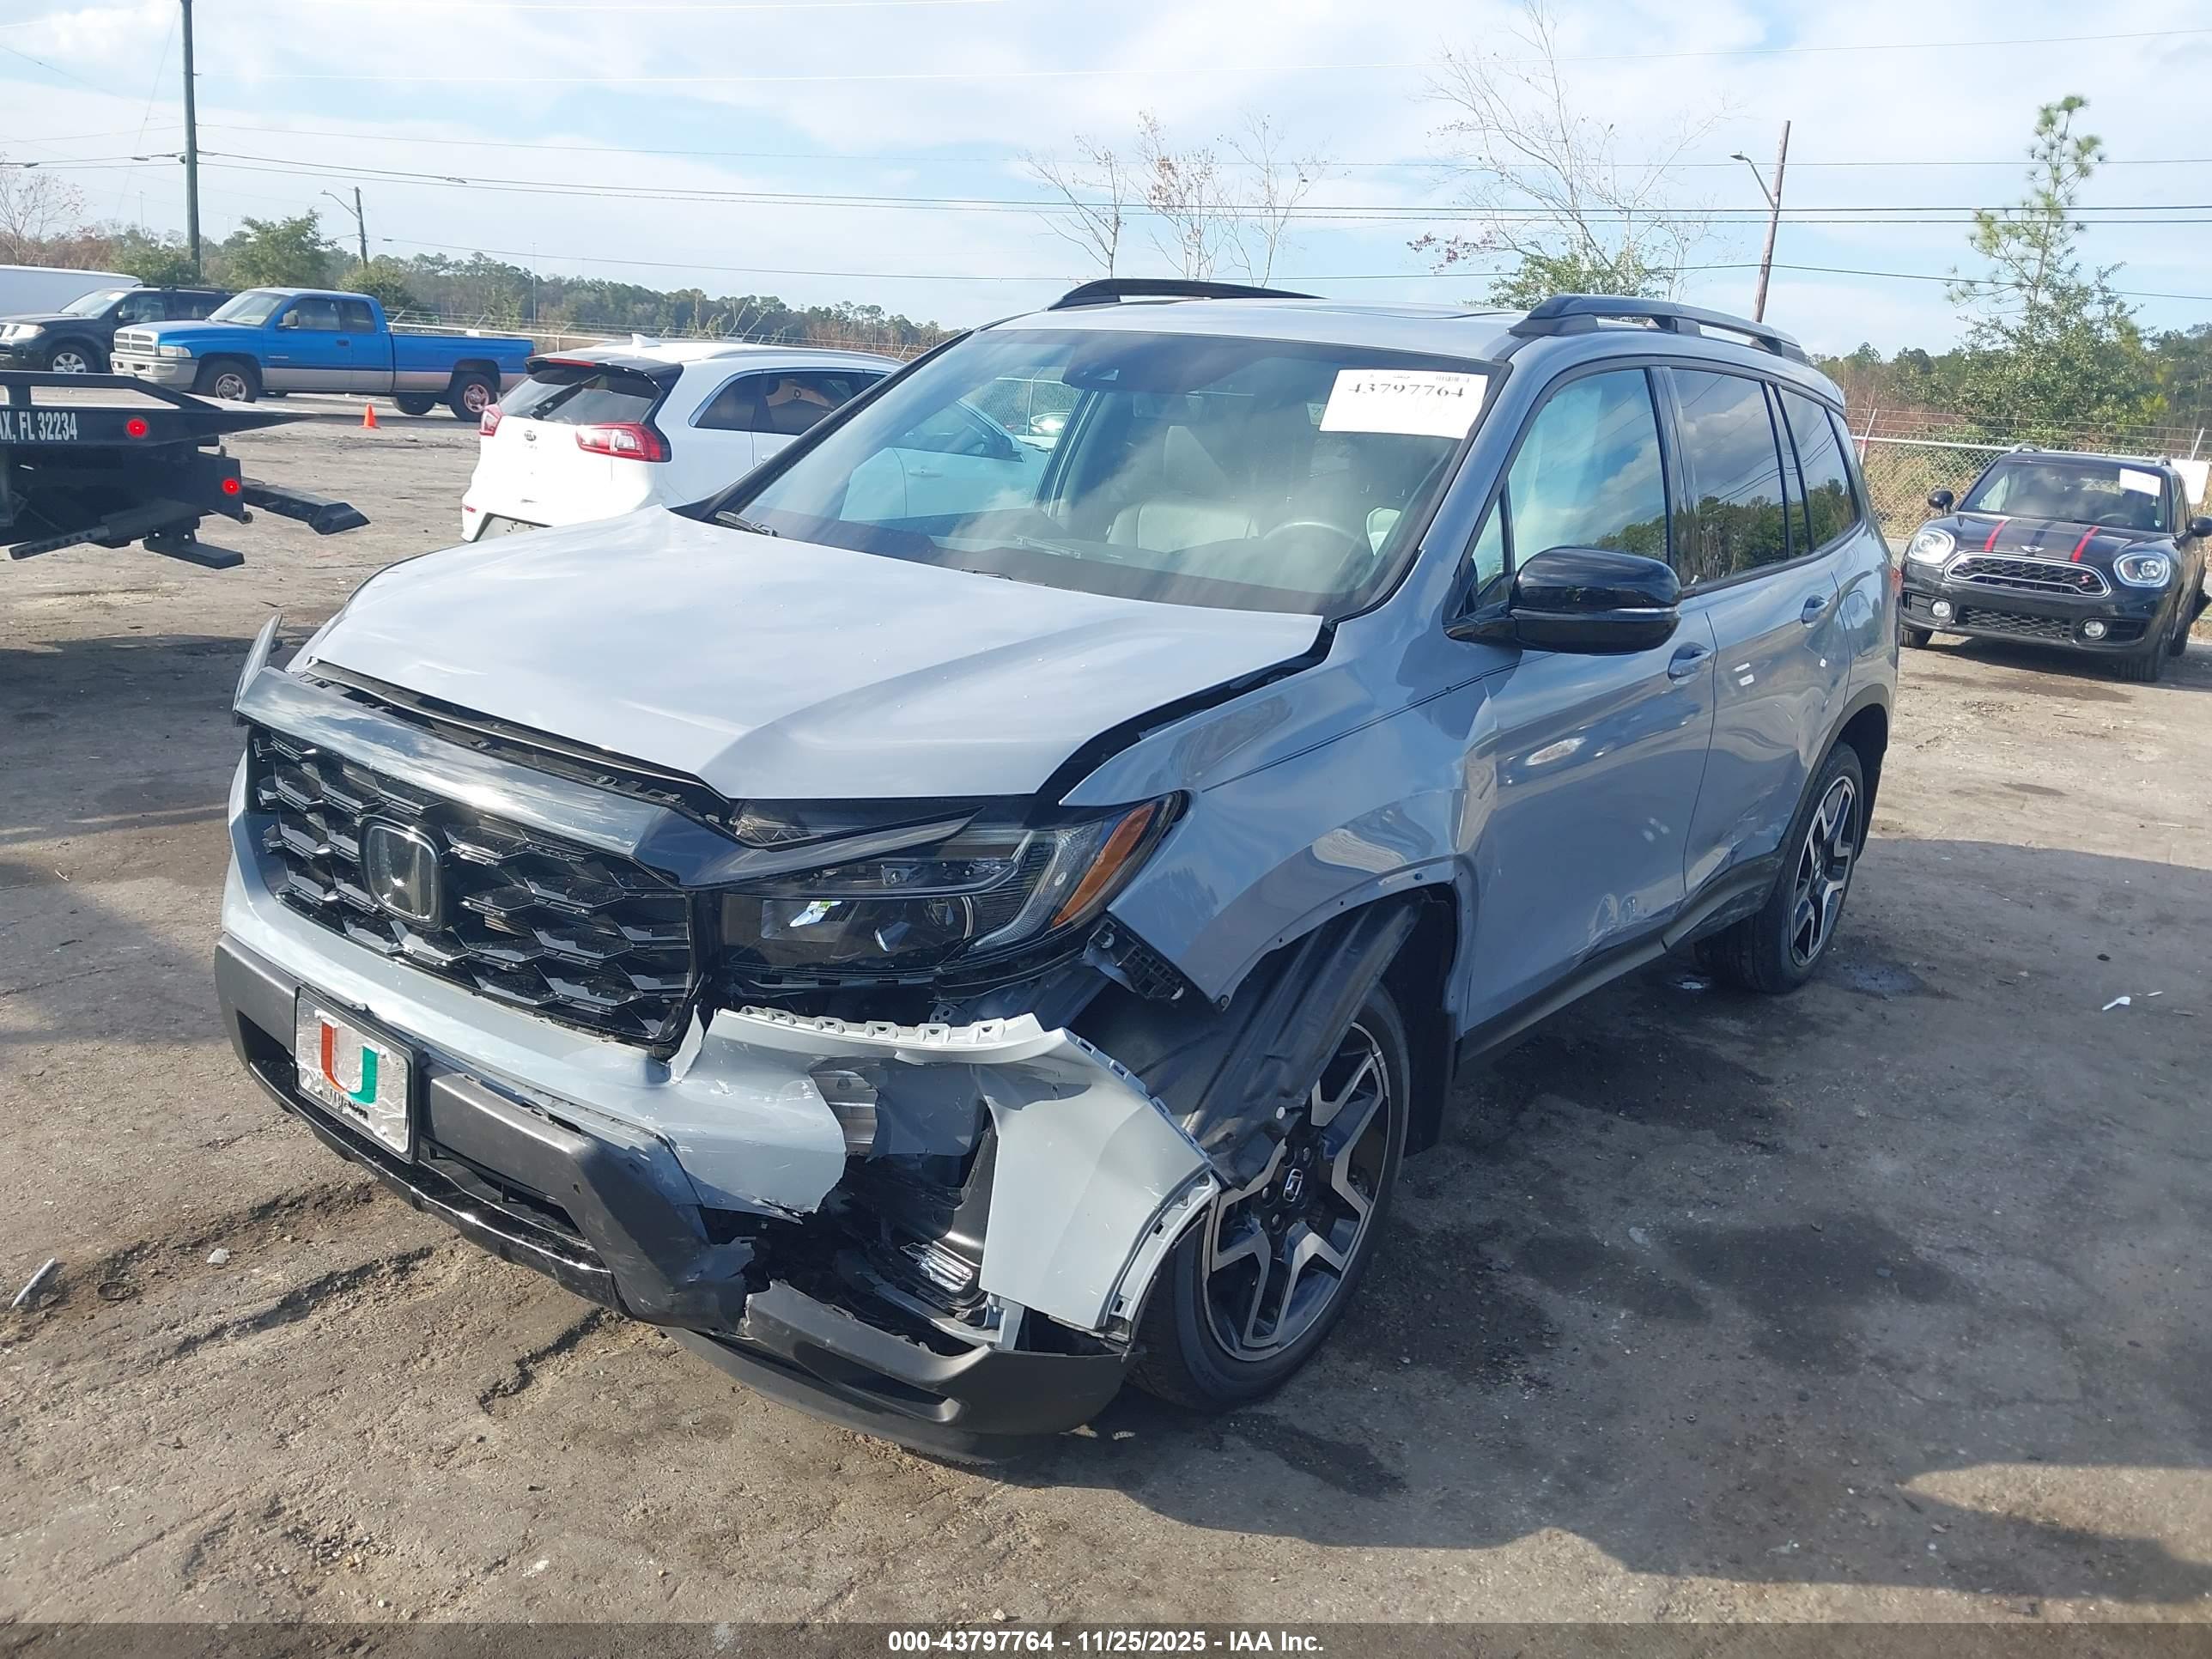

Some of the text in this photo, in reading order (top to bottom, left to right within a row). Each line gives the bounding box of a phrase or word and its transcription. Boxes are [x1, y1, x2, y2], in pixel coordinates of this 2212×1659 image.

[1348, 383, 1464, 398] 43797764
[19, 411, 35, 441] FL
[37, 412, 78, 441] 32234
